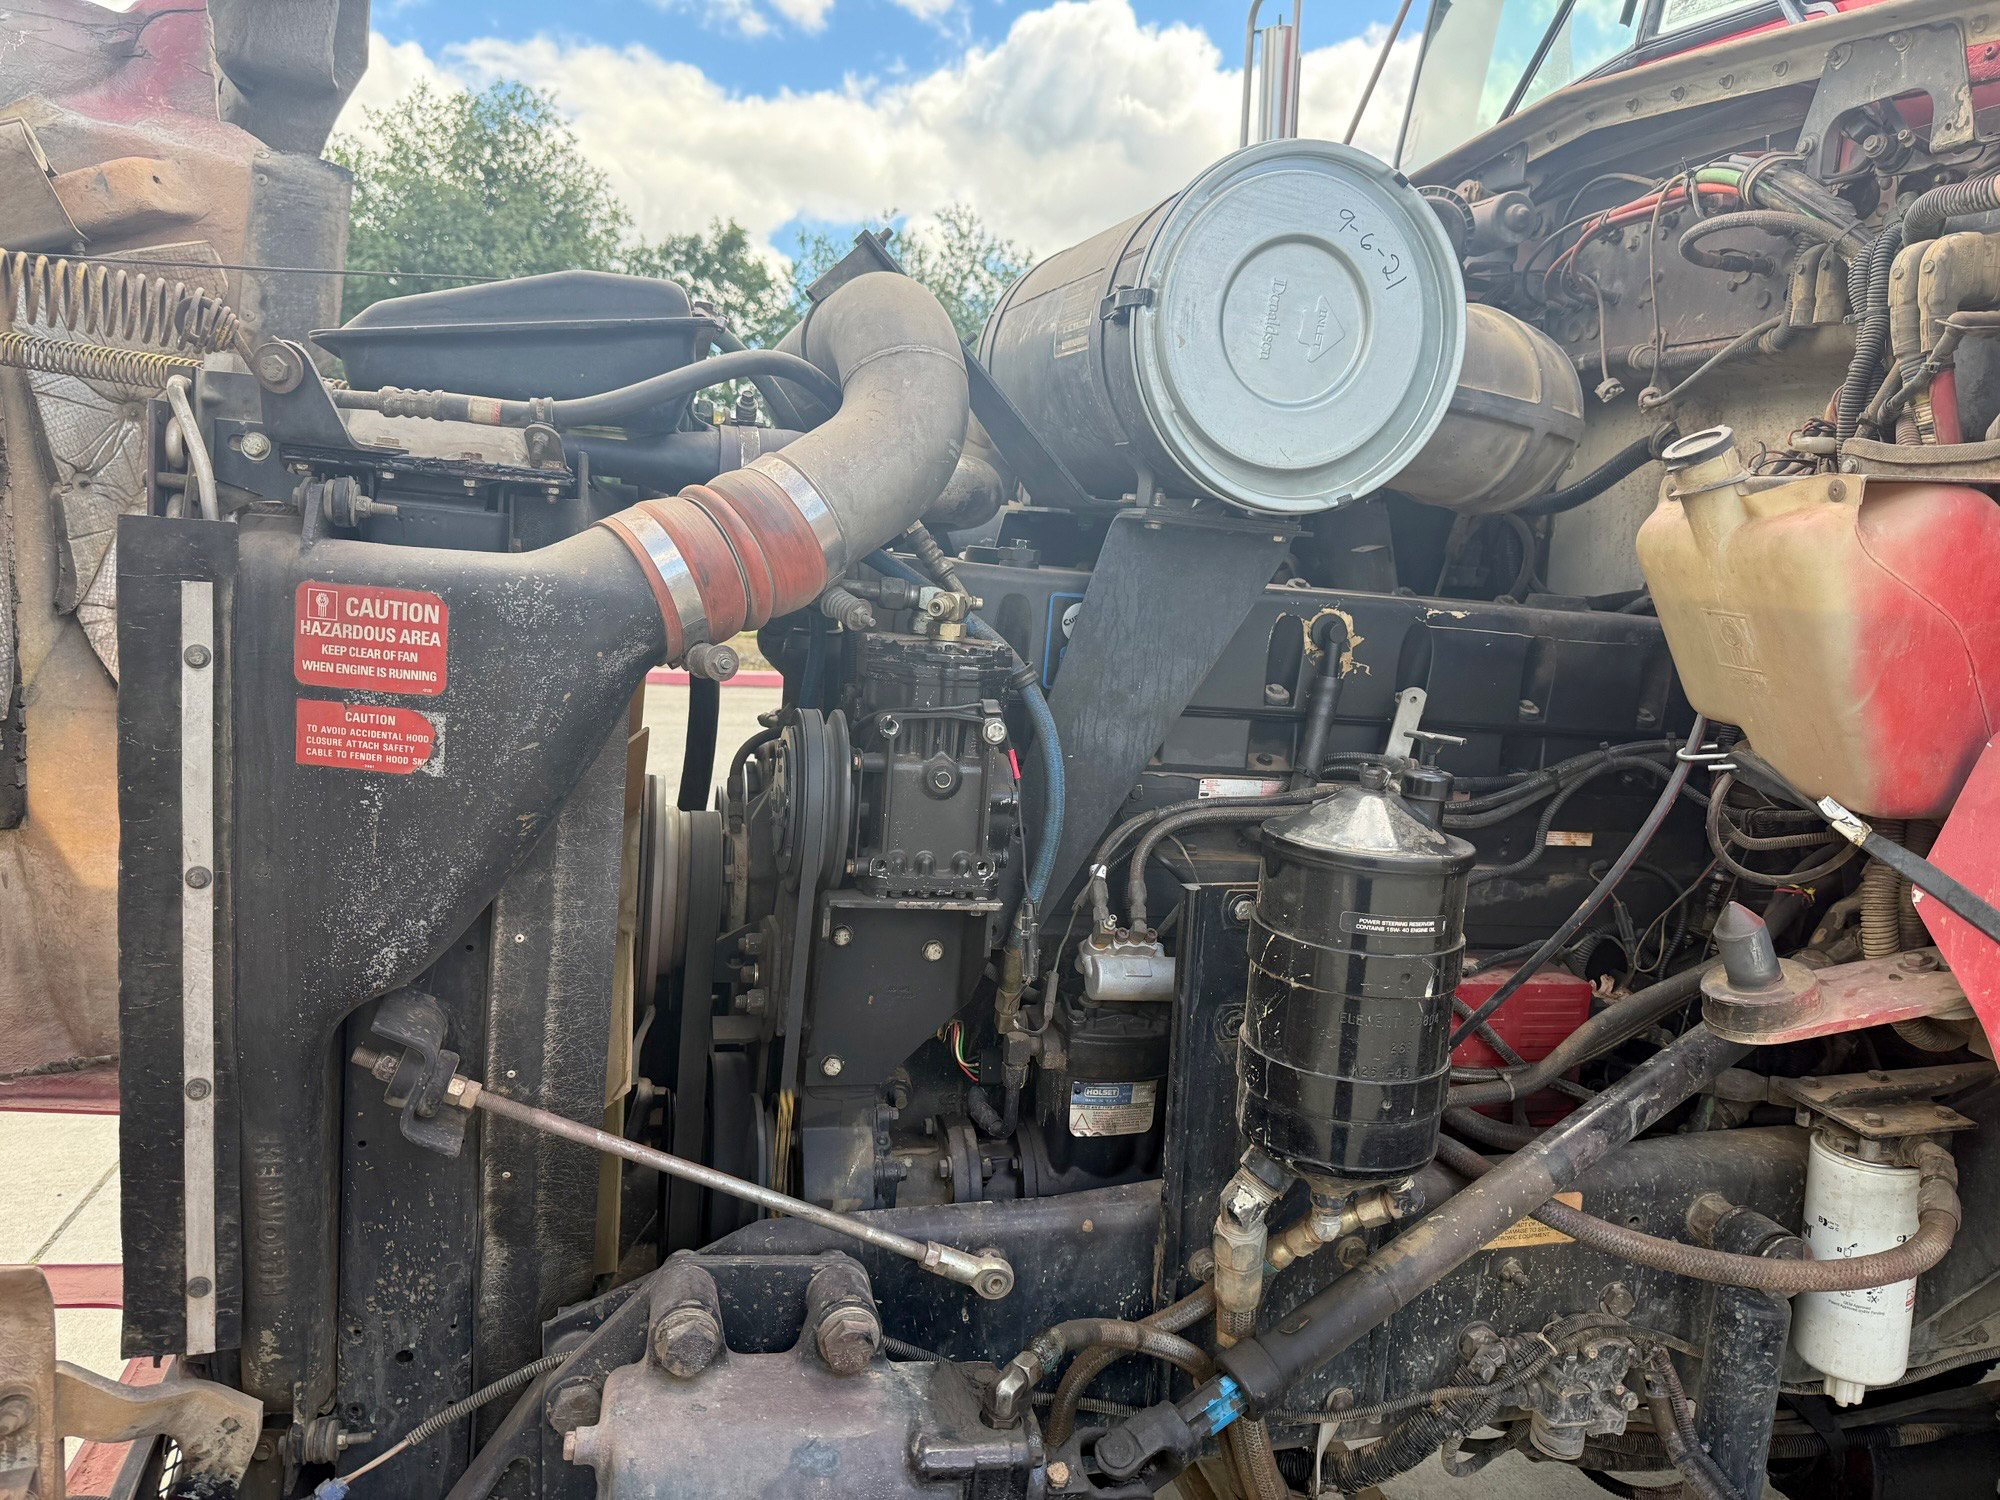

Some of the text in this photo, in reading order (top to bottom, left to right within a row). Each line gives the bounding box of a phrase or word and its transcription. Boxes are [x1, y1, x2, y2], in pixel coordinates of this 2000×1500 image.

[1339, 208, 1407, 290] 9-6-21
[1259, 277, 1288, 361] Donaldson
[1313, 308, 1328, 351] INLET
[345, 597, 440, 625] CAUTION
[300, 619, 441, 647] HAZARDOUS AREA
[321, 643, 418, 663] KEEP CLEAR OF FAN
[302, 659, 437, 682] WHEN ENGINE IS RUNNING
[345, 711, 396, 726] CAUTION
[306, 723, 429, 743] TO AVOID ACCIDENTAL HOOD
[306, 735, 415, 754] CLOSURE ATTACH SAFETY
[305, 748, 333, 758] CABLE
[336, 749, 347, 759] TO
[349, 751, 383, 763] FENDER
[385, 755, 409, 765] HOOD
[1355, 923, 1385, 932] CONTAINS
[1358, 917, 1381, 926] POWER
[1086, 1088, 1118, 1096] HOLSET
